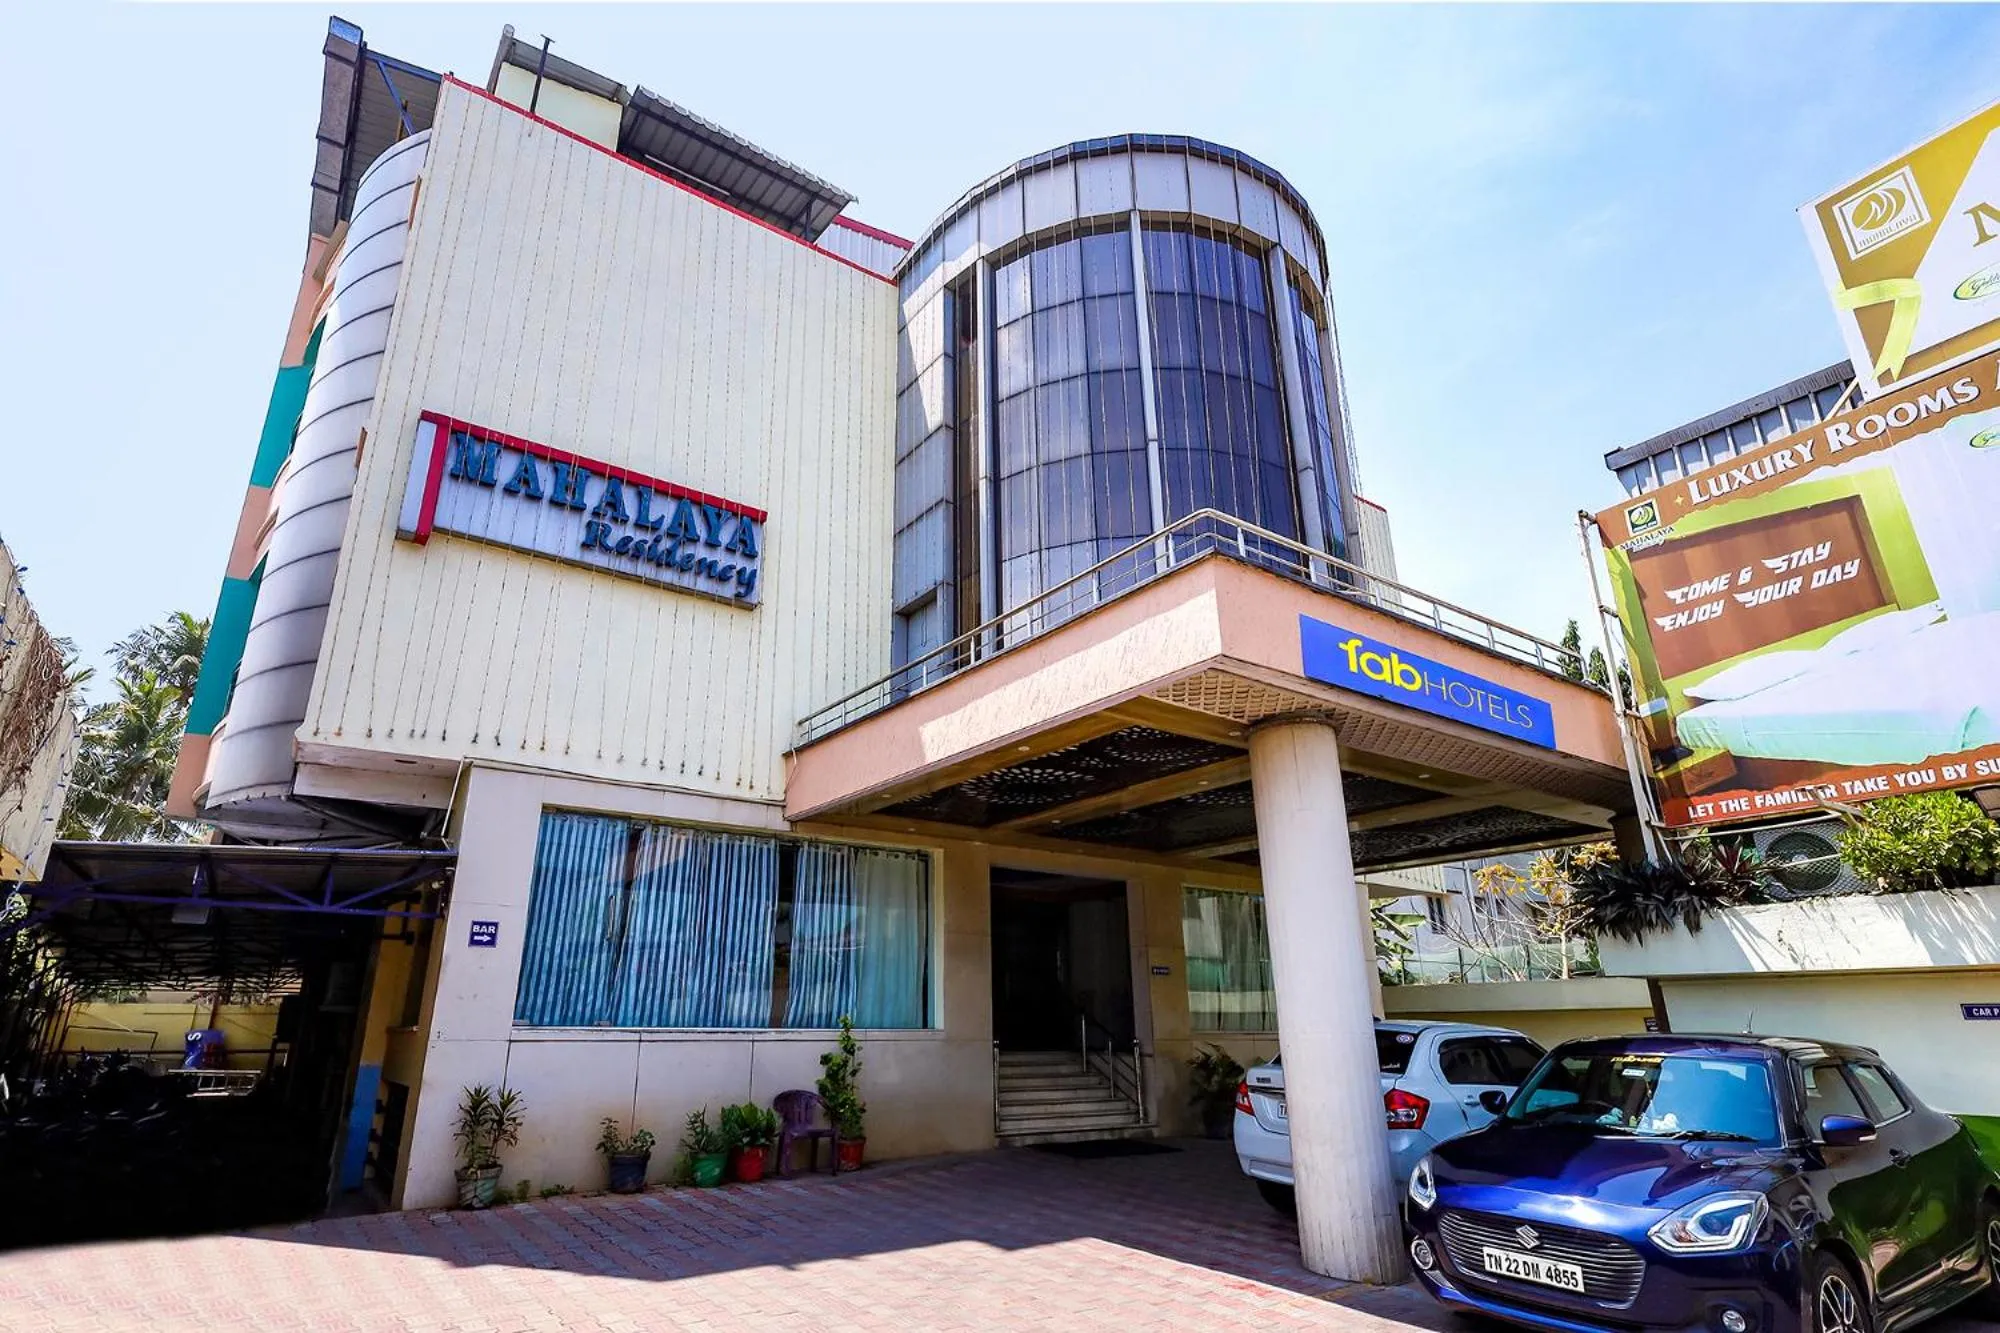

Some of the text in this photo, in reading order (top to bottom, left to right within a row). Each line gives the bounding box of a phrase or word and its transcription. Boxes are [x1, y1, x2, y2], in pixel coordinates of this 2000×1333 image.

[1687, 376, 1980, 505] LUXURY ROOMS
[450, 431, 760, 558] MAHALAYA
[581, 518, 758, 598] Residency
[1664, 573, 1732, 605] COME
[1761, 541, 1832, 574] STAY
[1653, 558, 1861, 632] ENJOY YOUR DAY
[1338, 638, 1533, 729] fab HOTELS
[1688, 757, 2000, 819] LET THE FAMILR TAKE YOU BY SU
[472, 924, 496, 934] BAR
[1972, 1007, 1992, 1017] CAR
[1486, 1252, 1579, 1289] TN 22 DM 4855
